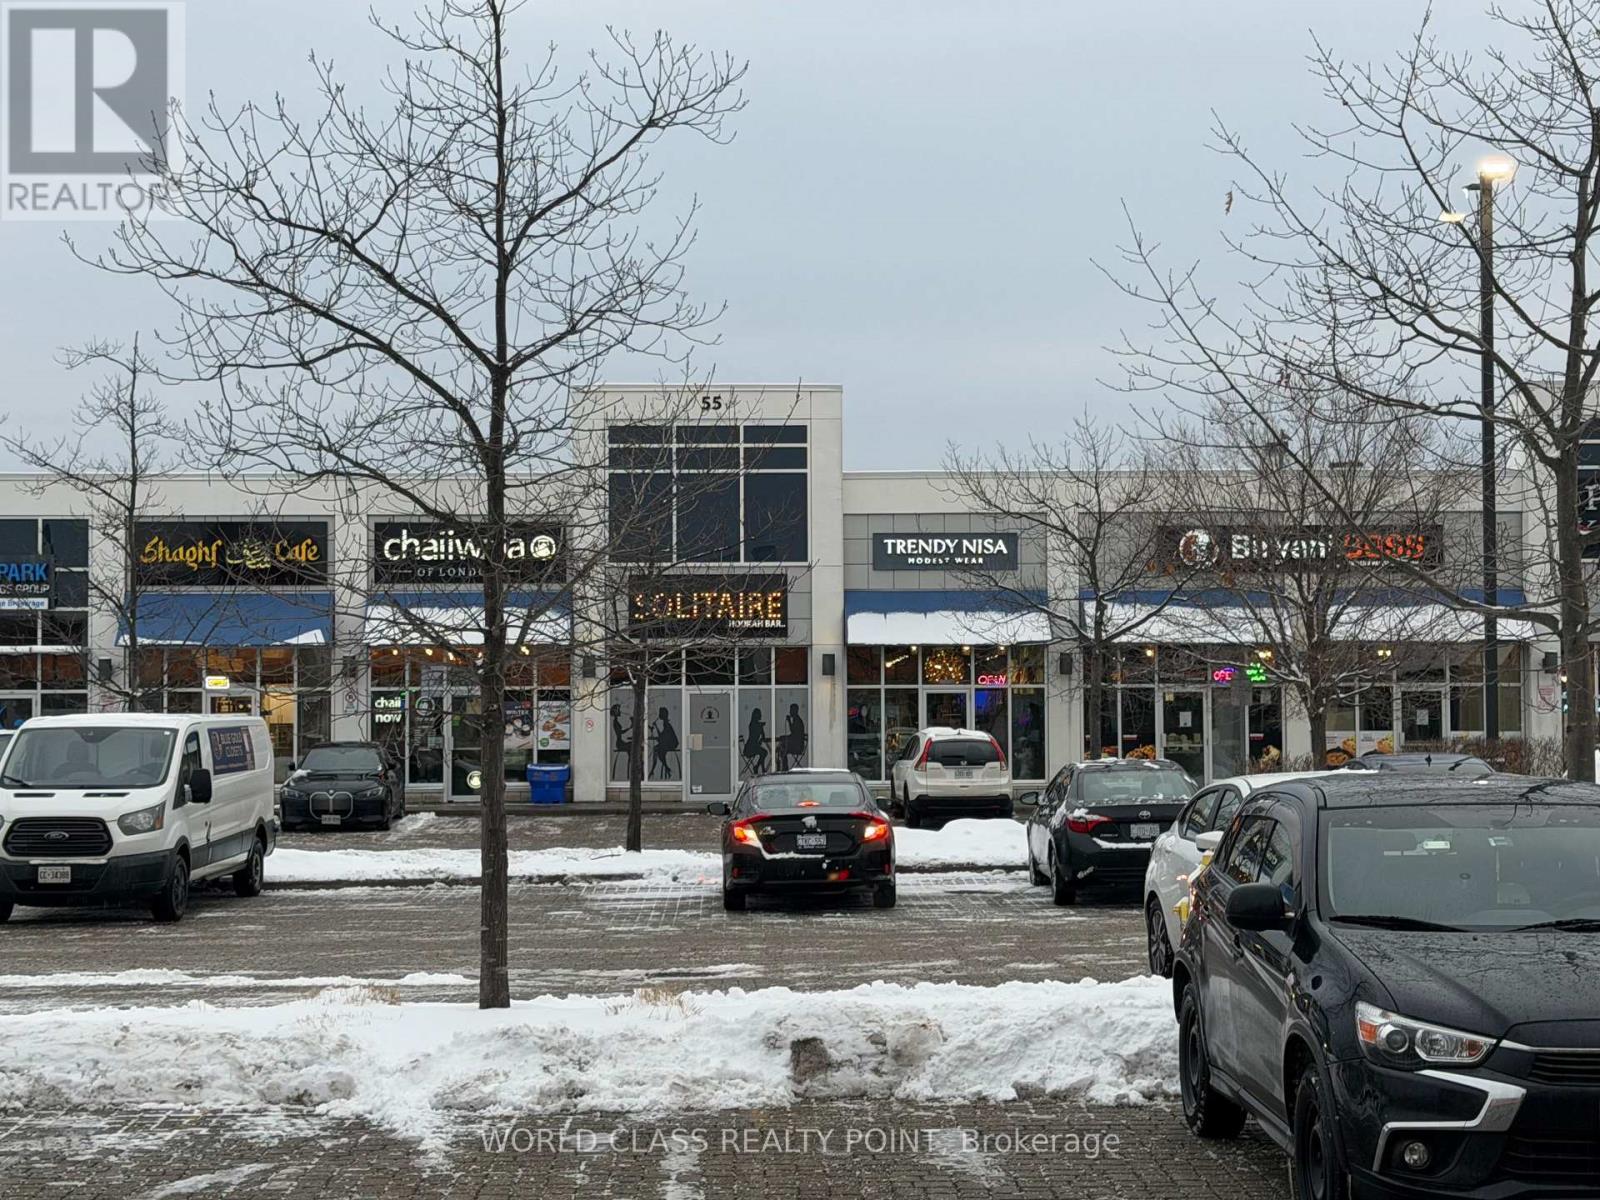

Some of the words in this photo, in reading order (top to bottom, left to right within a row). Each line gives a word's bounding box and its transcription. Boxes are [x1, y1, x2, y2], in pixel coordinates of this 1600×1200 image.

[701, 396, 722, 410] 55
[275, 537, 320, 566] Cafe
[883, 539, 958, 554] TRENDY
[962, 539, 1008, 554] NISA
[417, 568, 432, 576] OF
[438, 567, 484, 577] LOND
[633, 592, 783, 619] SOLITAIRE
[977, 674, 1007, 685] OPEN
[375, 713, 402, 723] now
